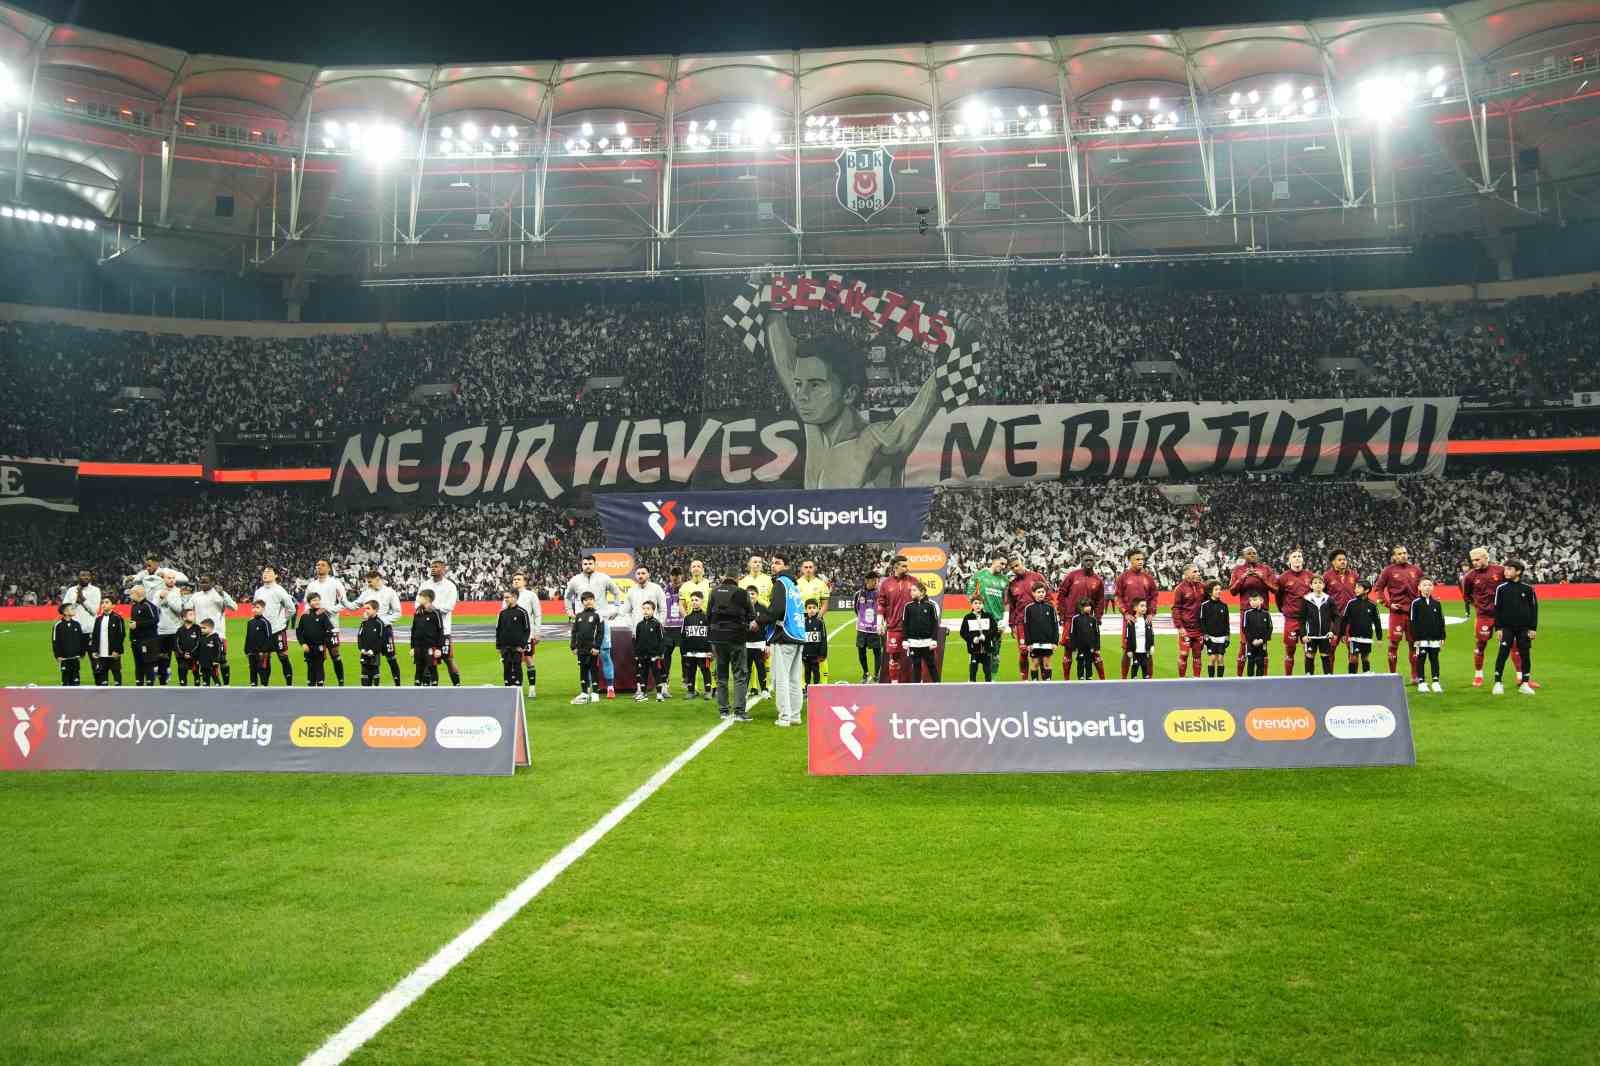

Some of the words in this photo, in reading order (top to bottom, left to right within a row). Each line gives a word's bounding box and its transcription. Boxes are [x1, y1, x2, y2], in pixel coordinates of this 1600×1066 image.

[847, 153, 882, 169] BJK
[940, 414, 1041, 481] NE
[1202, 404, 1438, 475] TUTKU
[332, 428, 423, 497] NE
[573, 418, 800, 486] HEVES
[682, 504, 794, 530] trendyol
[57, 714, 176, 744] trendyol
[368, 724, 421, 739] trendyol
[889, 712, 1029, 744] trendyol
[1252, 716, 1310, 730] trendyol
